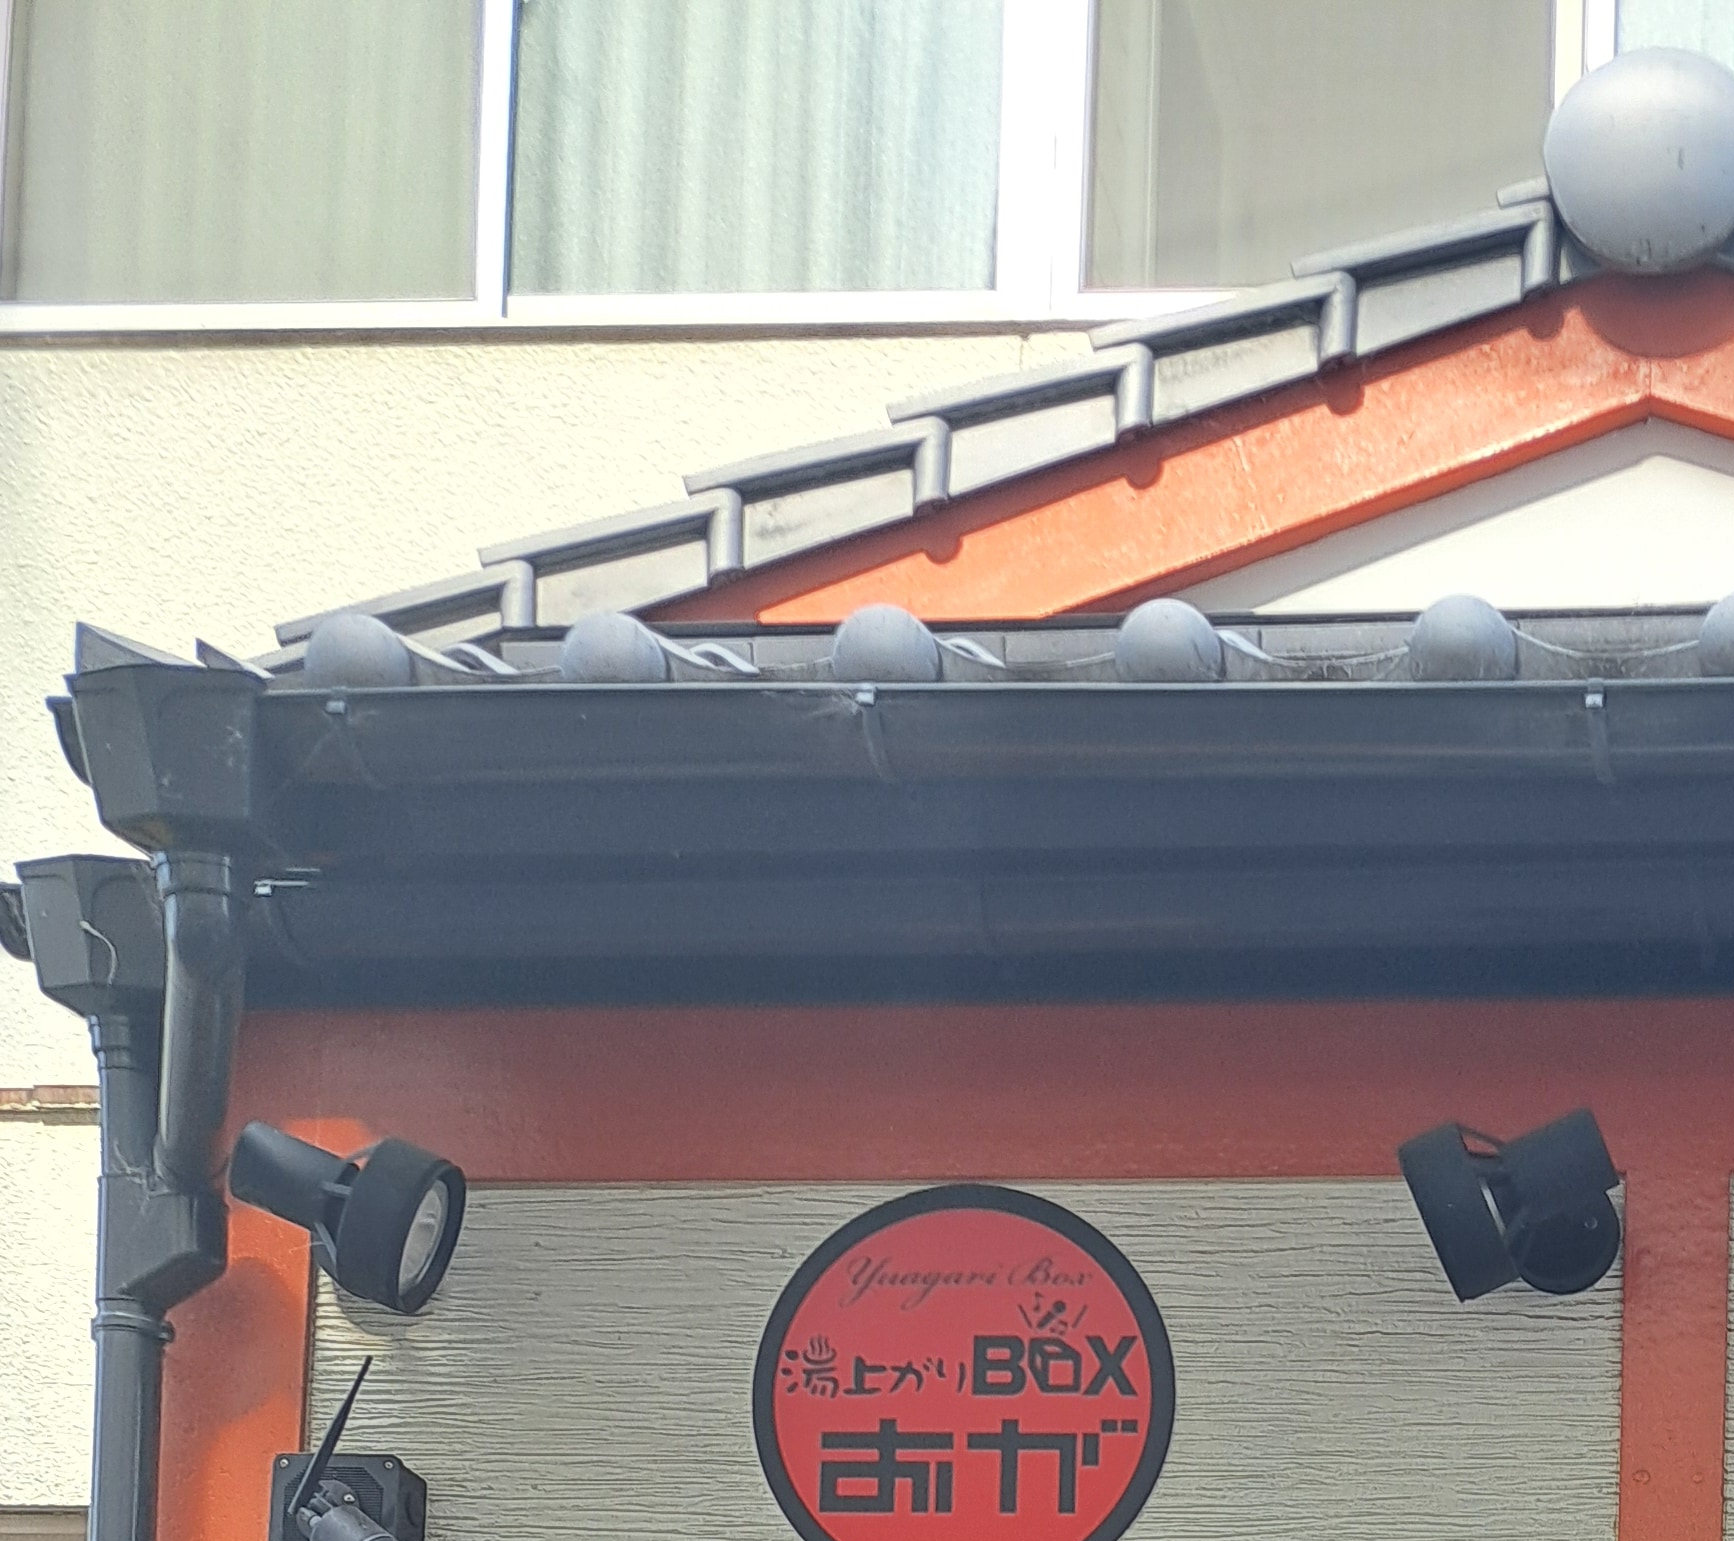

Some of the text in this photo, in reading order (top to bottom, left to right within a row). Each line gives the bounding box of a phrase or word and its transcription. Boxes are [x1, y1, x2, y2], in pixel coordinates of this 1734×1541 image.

[840, 1255, 1093, 1310] Yuagari Box
[819, 1419, 1138, 1514] おが
